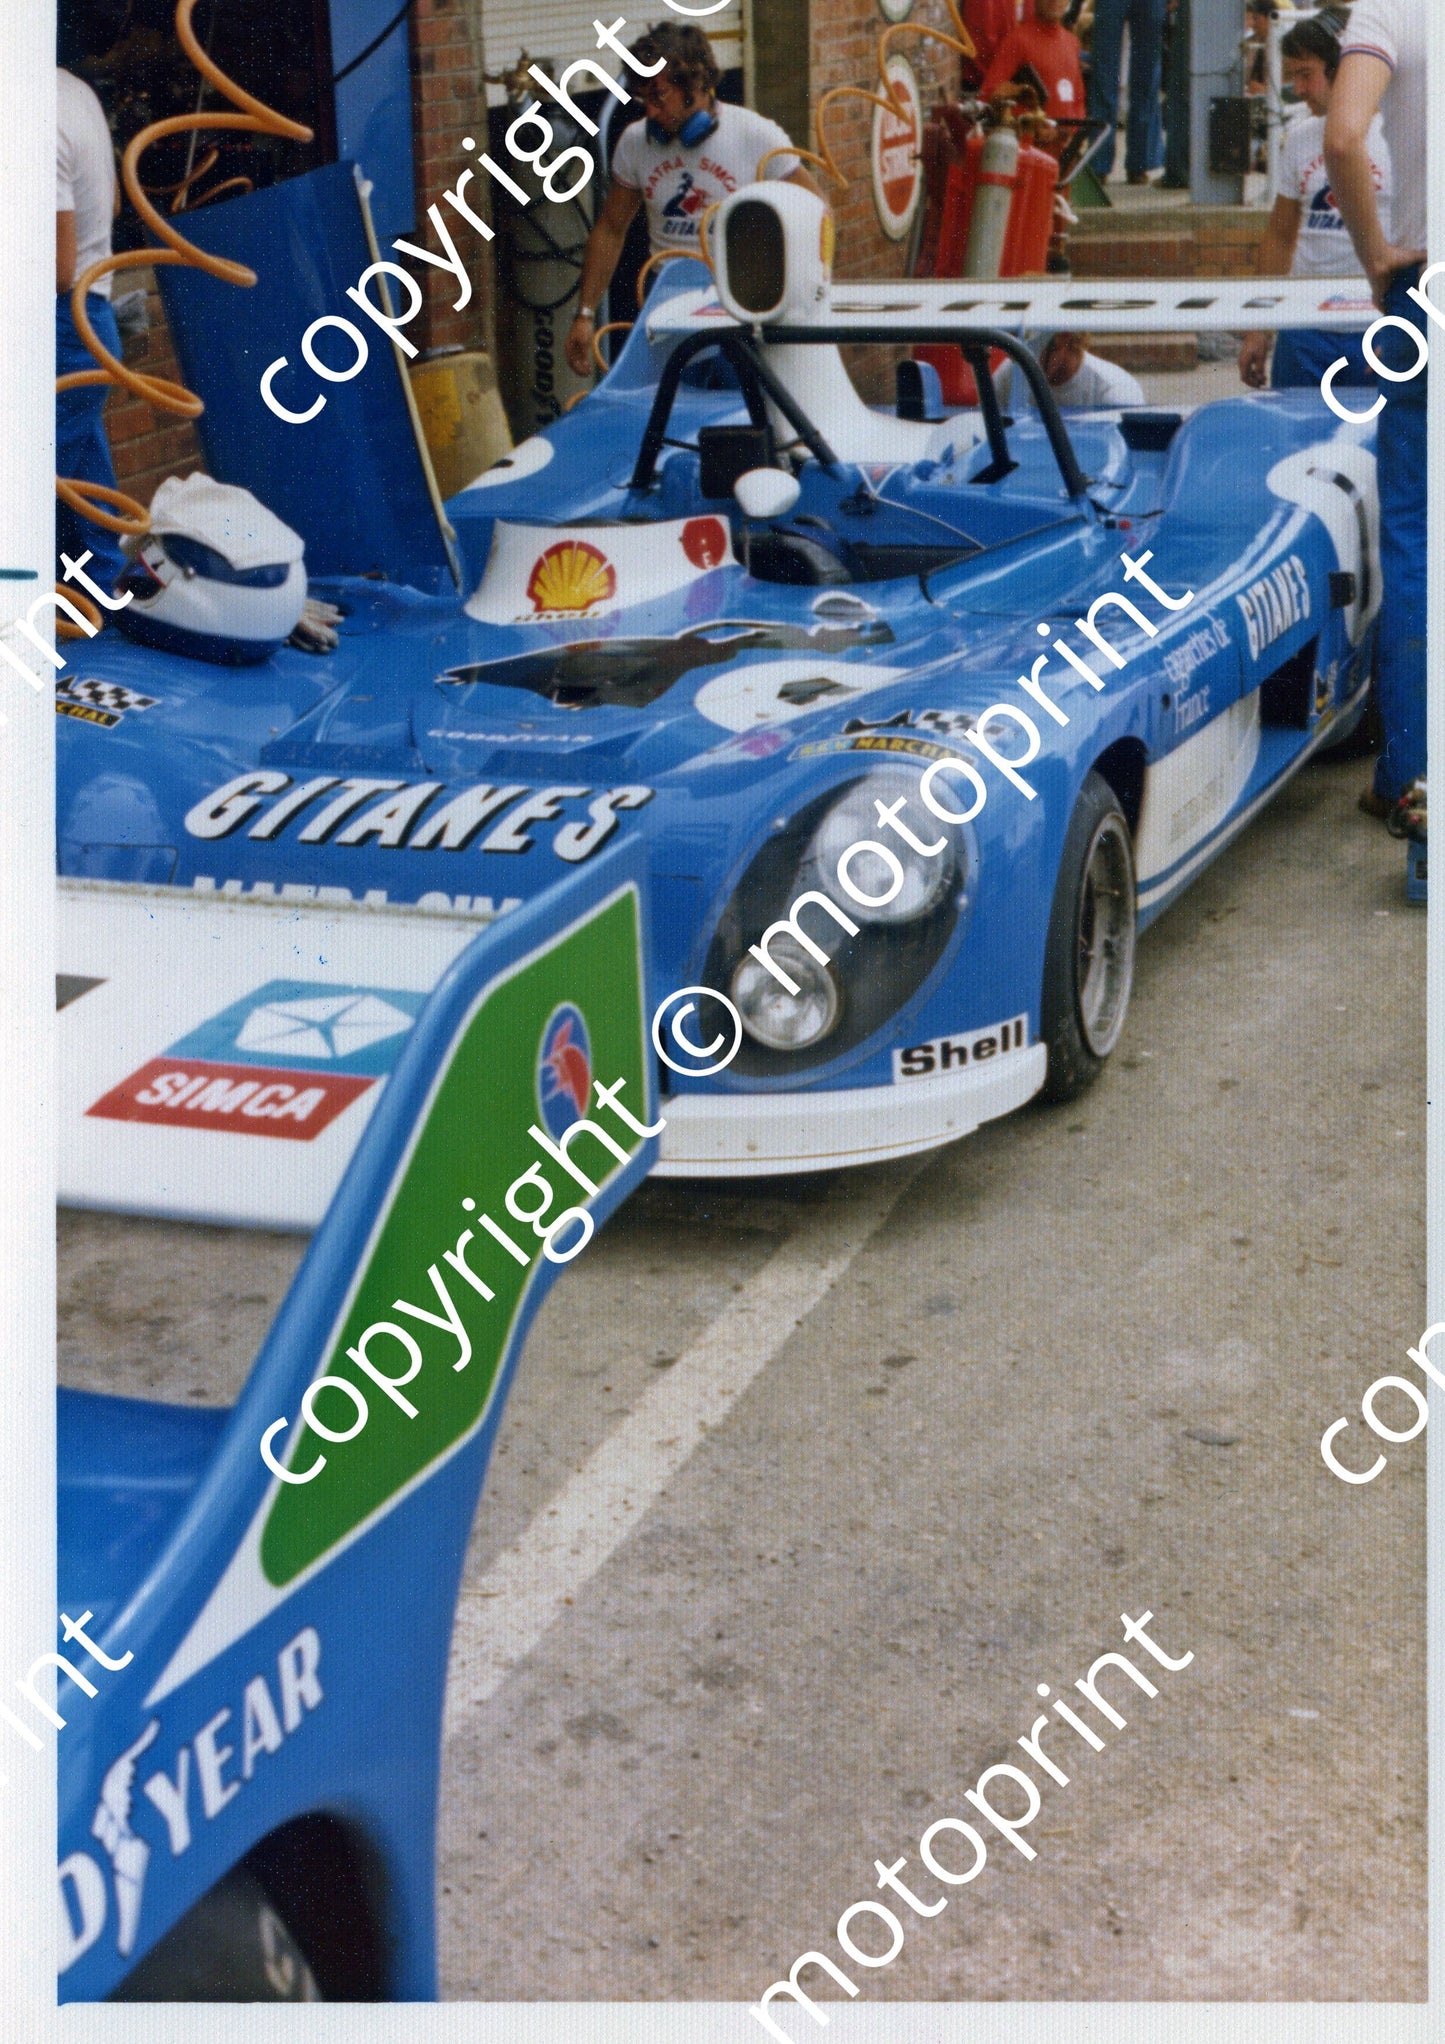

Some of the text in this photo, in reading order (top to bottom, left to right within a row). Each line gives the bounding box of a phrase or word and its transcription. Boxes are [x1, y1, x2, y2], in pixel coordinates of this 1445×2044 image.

[1236, 555, 1311, 663] GITANES
[856, 735, 968, 760] MARCHA
[184, 770, 655, 863] GITANES
[899, 1019, 1025, 1077] Shell
[136, 1072, 328, 1122] SIMCA
